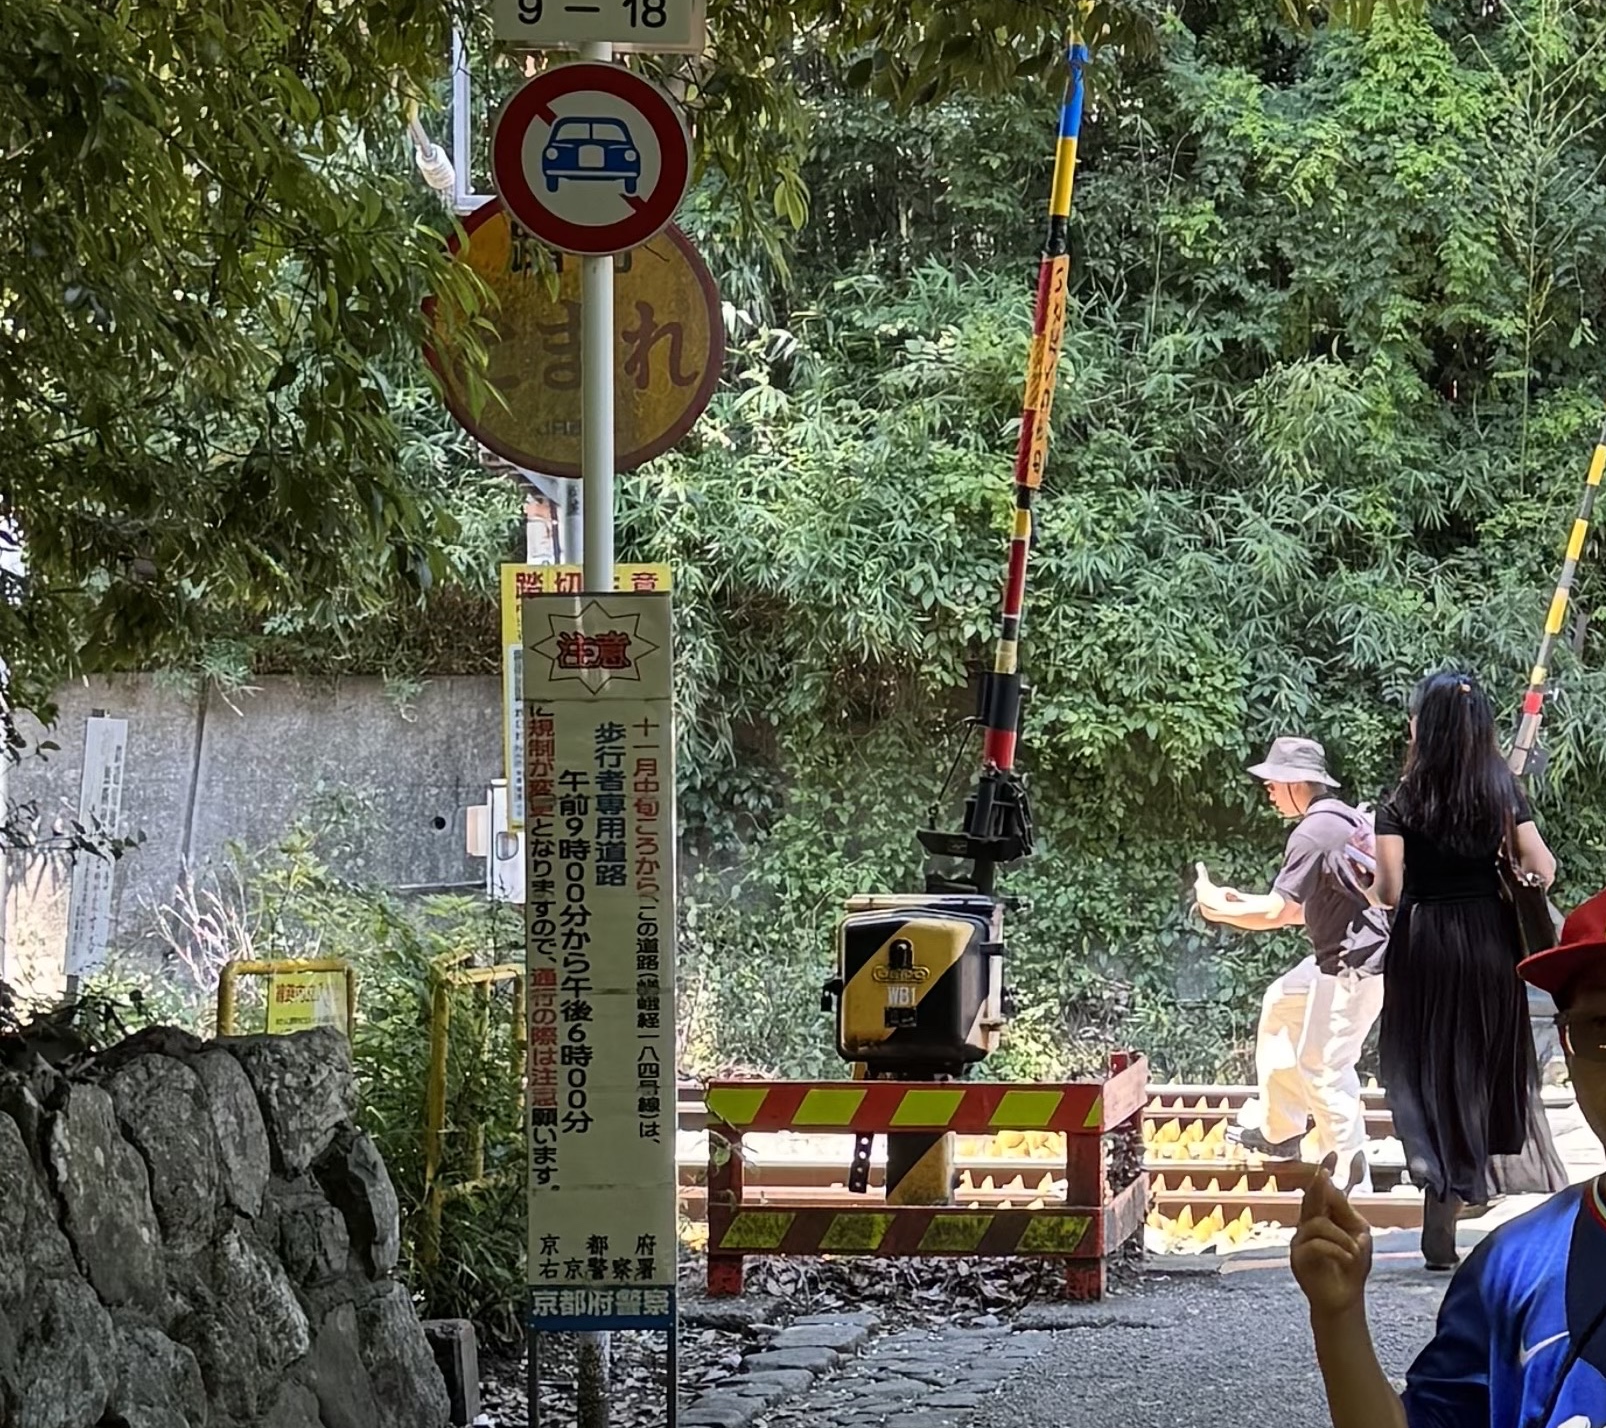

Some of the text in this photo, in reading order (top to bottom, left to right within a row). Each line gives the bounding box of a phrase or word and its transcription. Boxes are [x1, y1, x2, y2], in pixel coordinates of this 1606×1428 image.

[556, 630, 632, 669] 注意
[594, 721, 627, 886] 歩行者専用道路
[558, 770, 594, 1133] 午前9時00分から午後6時00分
[540, 1233, 657, 1256] 京都府
[539, 1257, 657, 1281] 右京警察署
[532, 1289, 669, 1316] 京都府警察
